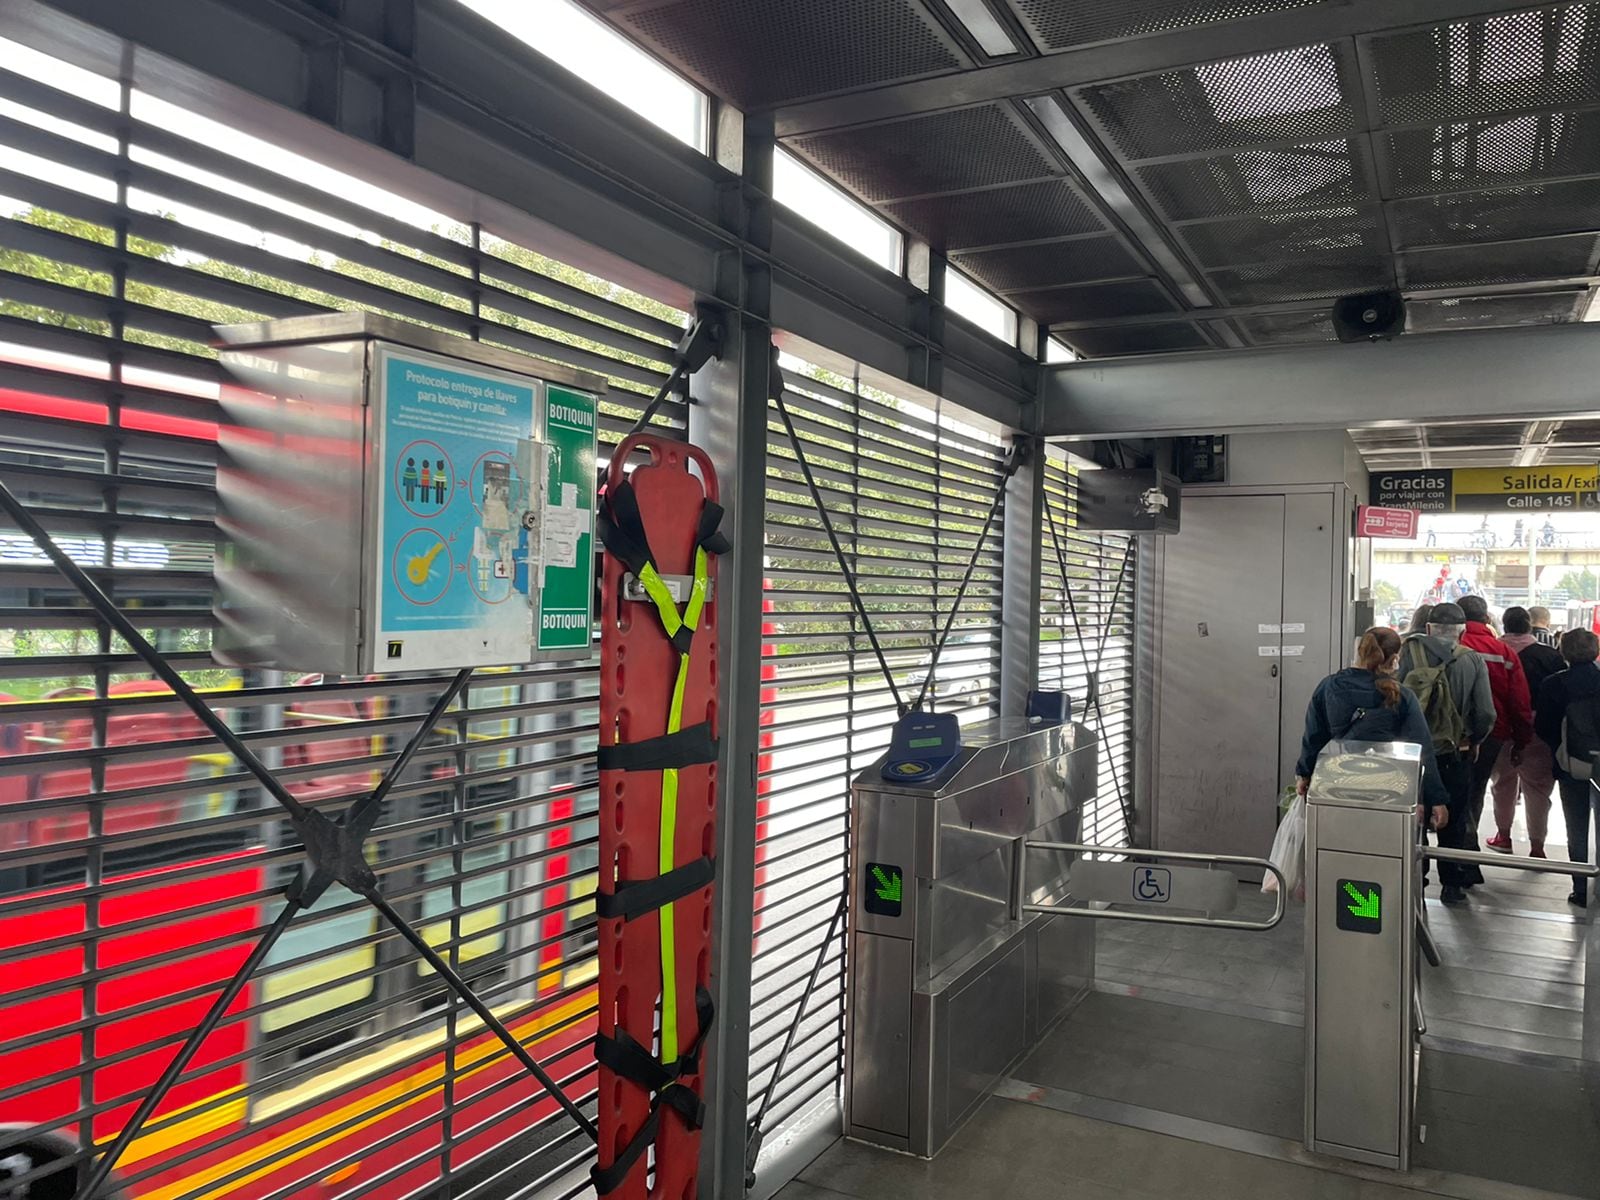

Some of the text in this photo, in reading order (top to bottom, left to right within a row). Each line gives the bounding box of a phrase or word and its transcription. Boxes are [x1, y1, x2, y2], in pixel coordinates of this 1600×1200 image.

[406, 370, 517, 404] Protocolo entrega de llaves
[417, 391, 436, 403] para
[471, 402, 478, 412] y
[549, 403, 593, 427] BOTIQUIN
[1380, 475, 1446, 490] Gracias
[1379, 490, 1445, 500] por viajar con
[1507, 495, 1572, 508] Calle 145
[542, 614, 587, 630] BOTIQUIN
